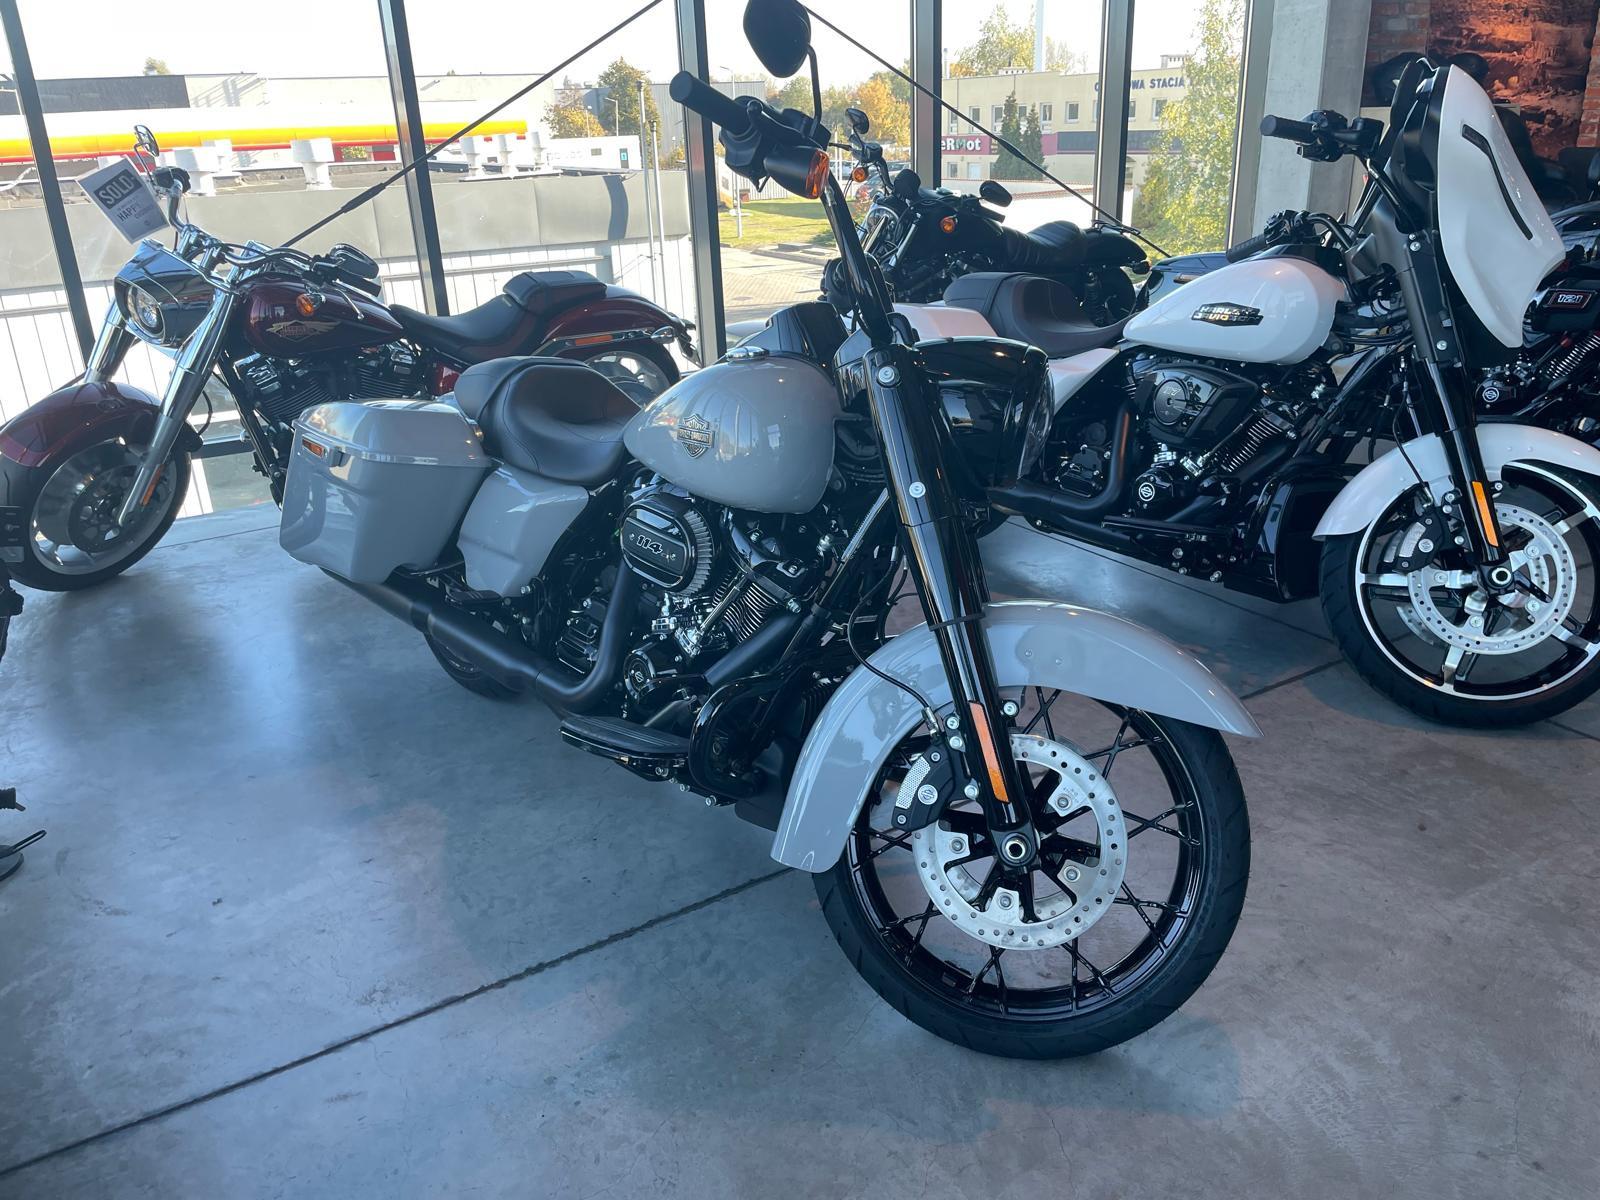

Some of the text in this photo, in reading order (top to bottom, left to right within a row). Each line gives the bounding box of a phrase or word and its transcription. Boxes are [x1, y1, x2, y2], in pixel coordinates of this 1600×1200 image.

[1149, 76, 1185, 89] STACJA
[941, 137, 981, 151] eRMot
[98, 174, 135, 205] SOLD
[636, 534, 663, 555] 114
